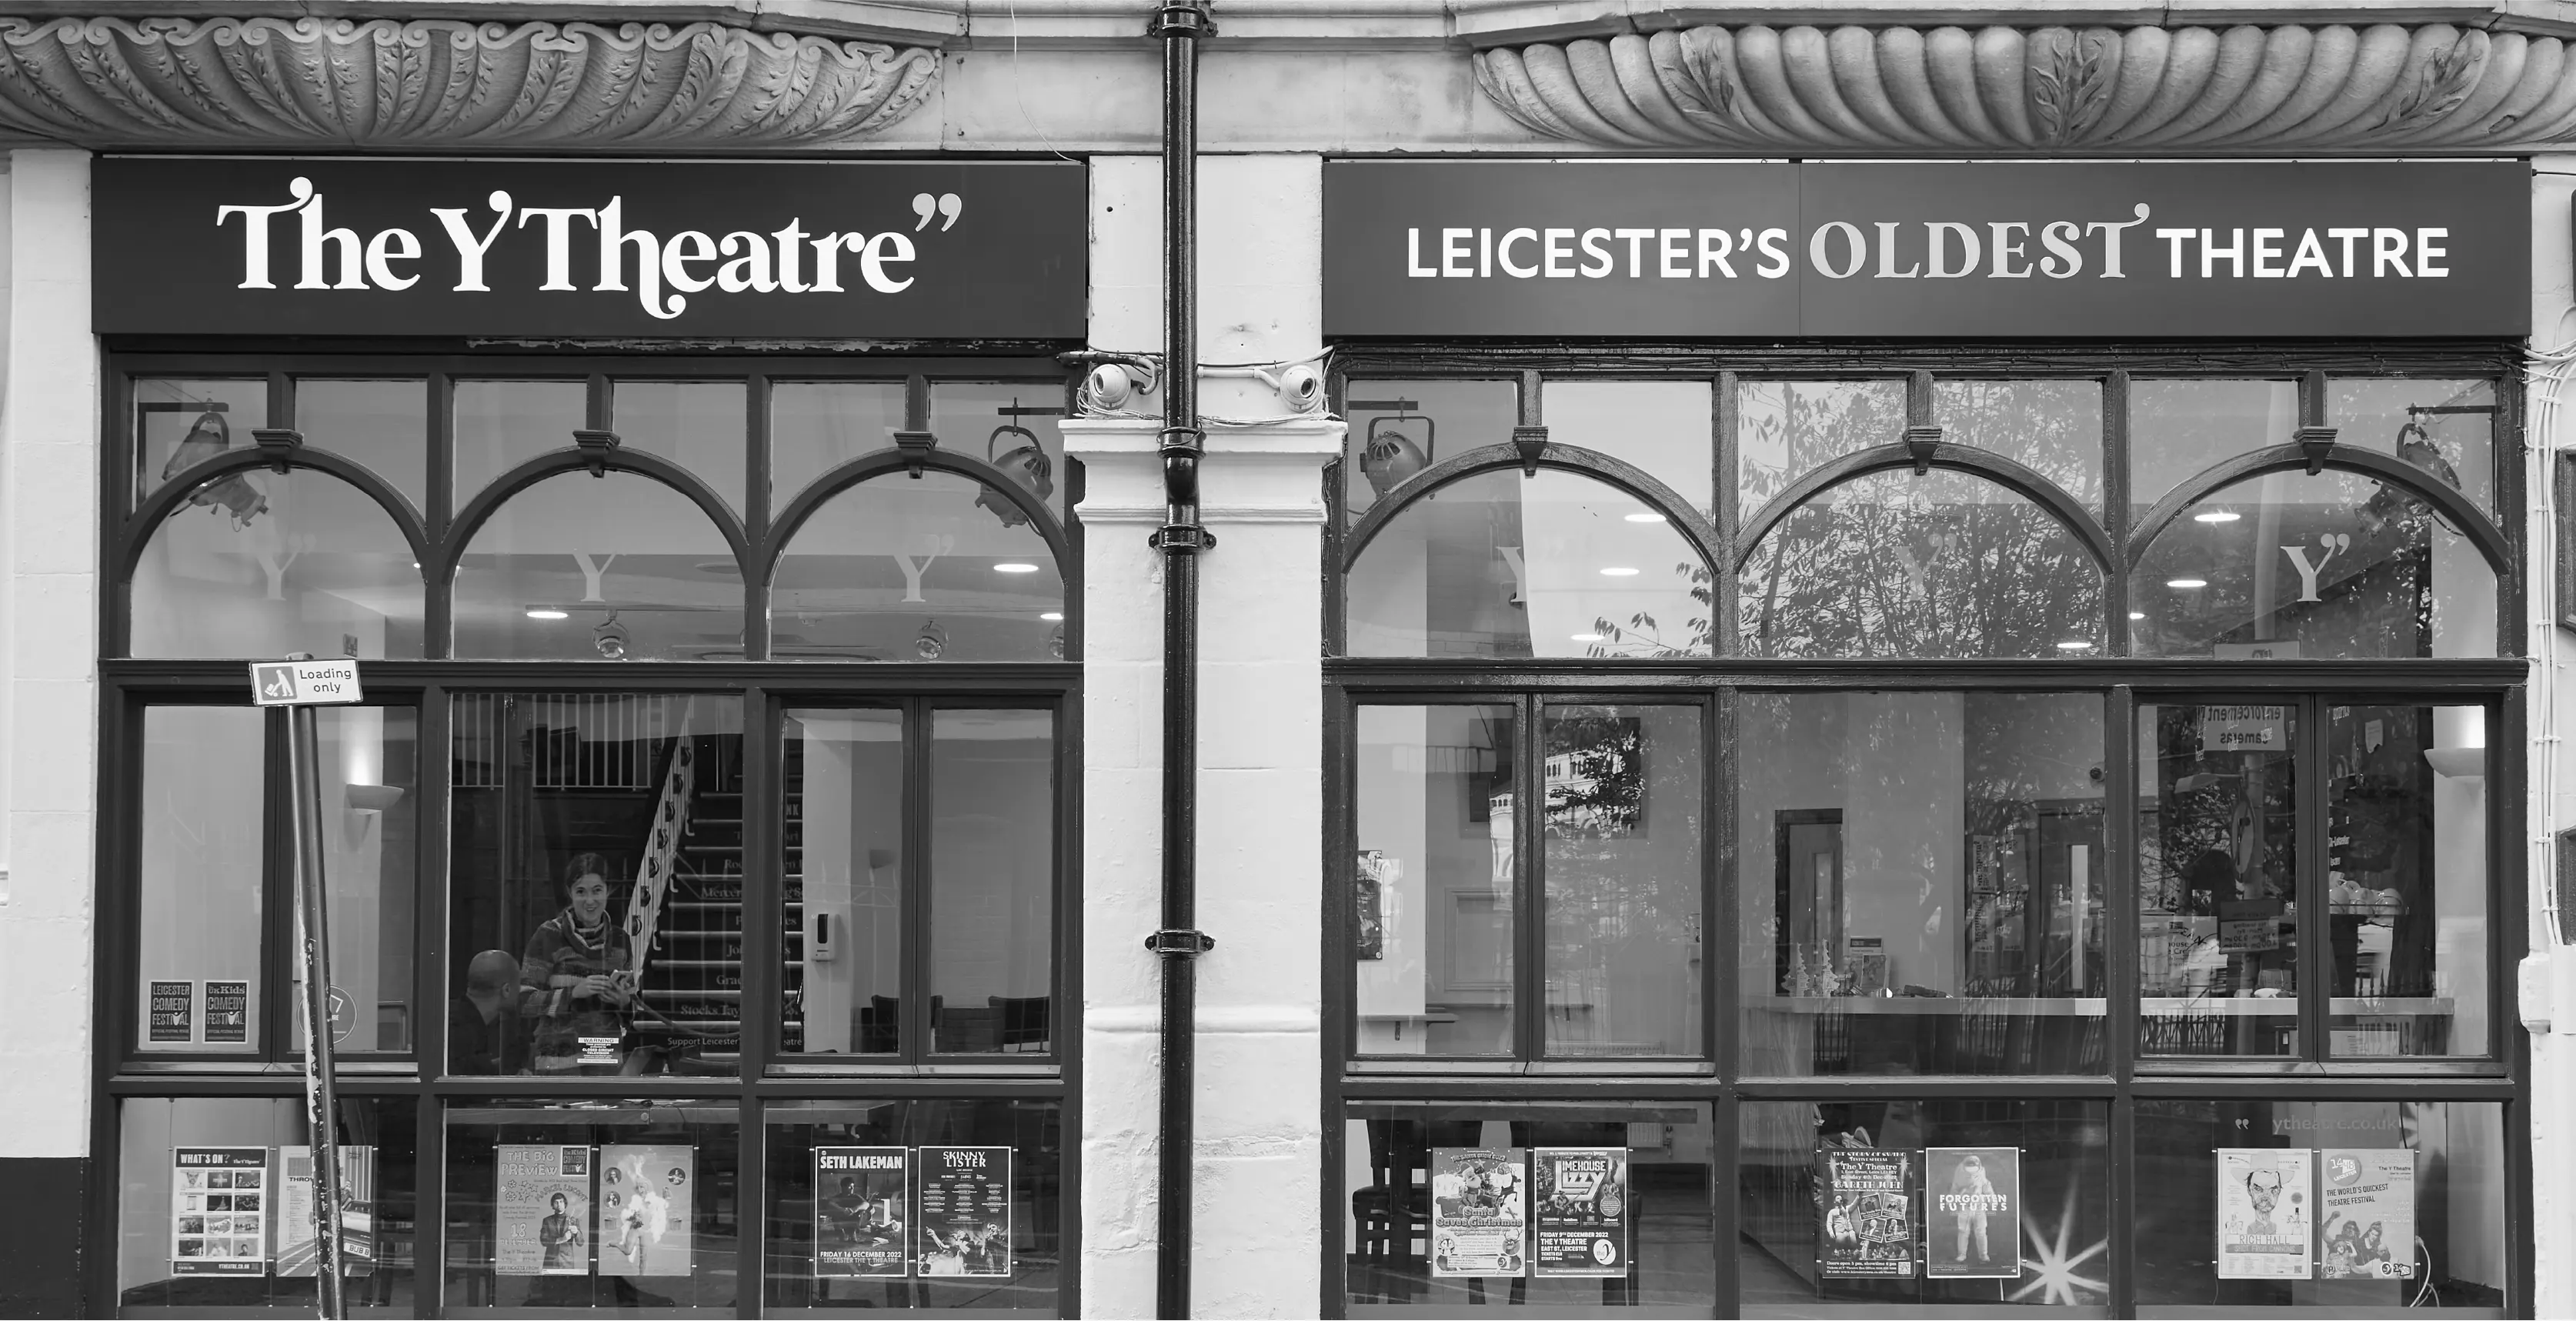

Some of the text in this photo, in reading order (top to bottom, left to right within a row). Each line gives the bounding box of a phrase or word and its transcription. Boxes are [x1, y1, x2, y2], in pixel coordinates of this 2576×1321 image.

[217, 176, 421, 292] The
[429, 190, 512, 292] Y
[1808, 202, 2151, 281] OLDEST
[2155, 227, 2449, 279] THEATRE
[299, 669, 352, 679] Loading
[313, 682, 341, 693] only
[153, 985, 190, 996] LEICESTER
[152, 997, 189, 1011] COMEDY
[207, 996, 245, 1010] COMEDY
[152, 1012, 189, 1026] FESTIVAL
[207, 1011, 245, 1025] FESTIVAL
[667, 1037, 700, 1049] Support
[2272, 1115, 2397, 1136] ytheatre.co.uk
[212, 1154, 230, 1164] ON?
[506, 1151, 529, 1162] THE
[562, 1155, 586, 1164] COMEDY
[943, 1151, 986, 1160] SKINNY
[820, 1156, 903, 1169] SETH LAKEMAN
[946, 1159, 986, 1167] LISTER
[1840, 1161, 1857, 1170] The
[1834, 1180, 1875, 1189] GARETH
[2363, 1183, 2388, 1193] QUICKEST
[1939, 1194, 2007, 1203] FORGOTTEN
[2327, 1196, 2375, 1207] THEATRE FESTIVAL
[1463, 1206, 1494, 1217] Santa
[1939, 1203, 2007, 1212] FUTURES
[1436, 1216, 1523, 1227] Saves Christmas
[511, 1223, 526, 1237] 18
[2239, 1235, 2290, 1245] RICH HALL
[349, 1243, 363, 1254] BUB
